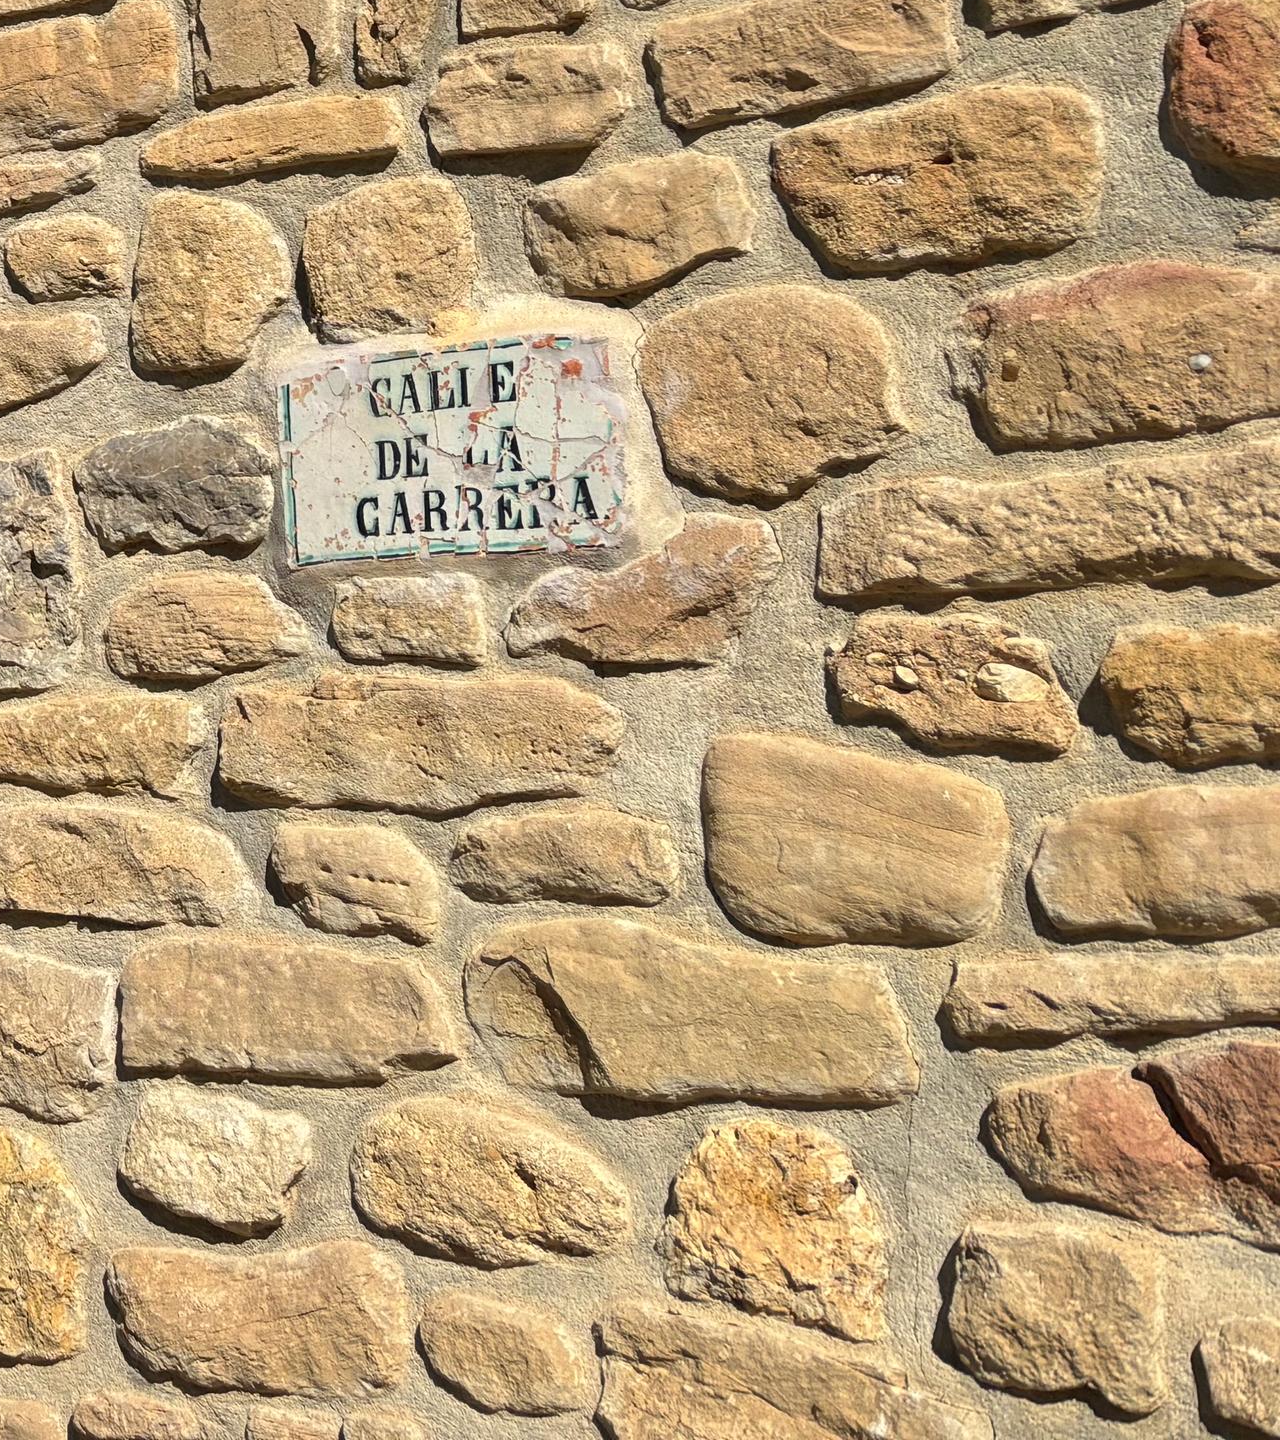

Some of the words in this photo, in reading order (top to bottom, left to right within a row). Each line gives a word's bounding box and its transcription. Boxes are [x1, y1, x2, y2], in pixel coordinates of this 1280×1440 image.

[369, 360, 517, 417] CALLE
[374, 434, 429, 480] DE
[463, 426, 526, 473] LA
